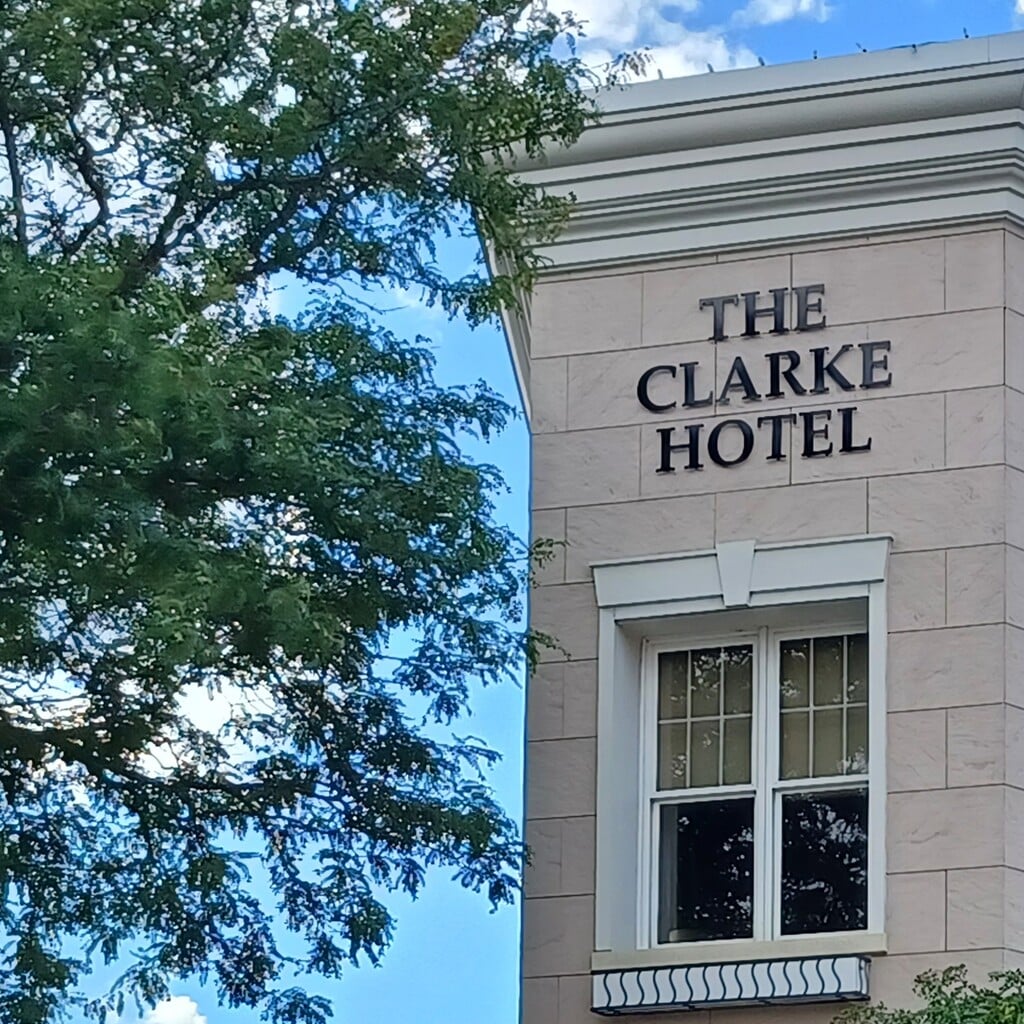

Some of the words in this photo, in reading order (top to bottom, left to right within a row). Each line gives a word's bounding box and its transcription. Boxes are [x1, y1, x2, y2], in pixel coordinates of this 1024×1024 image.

[700, 284, 826, 341] THE
[637, 341, 892, 413] CLARKE
[656, 407, 872, 473] HOTEL
